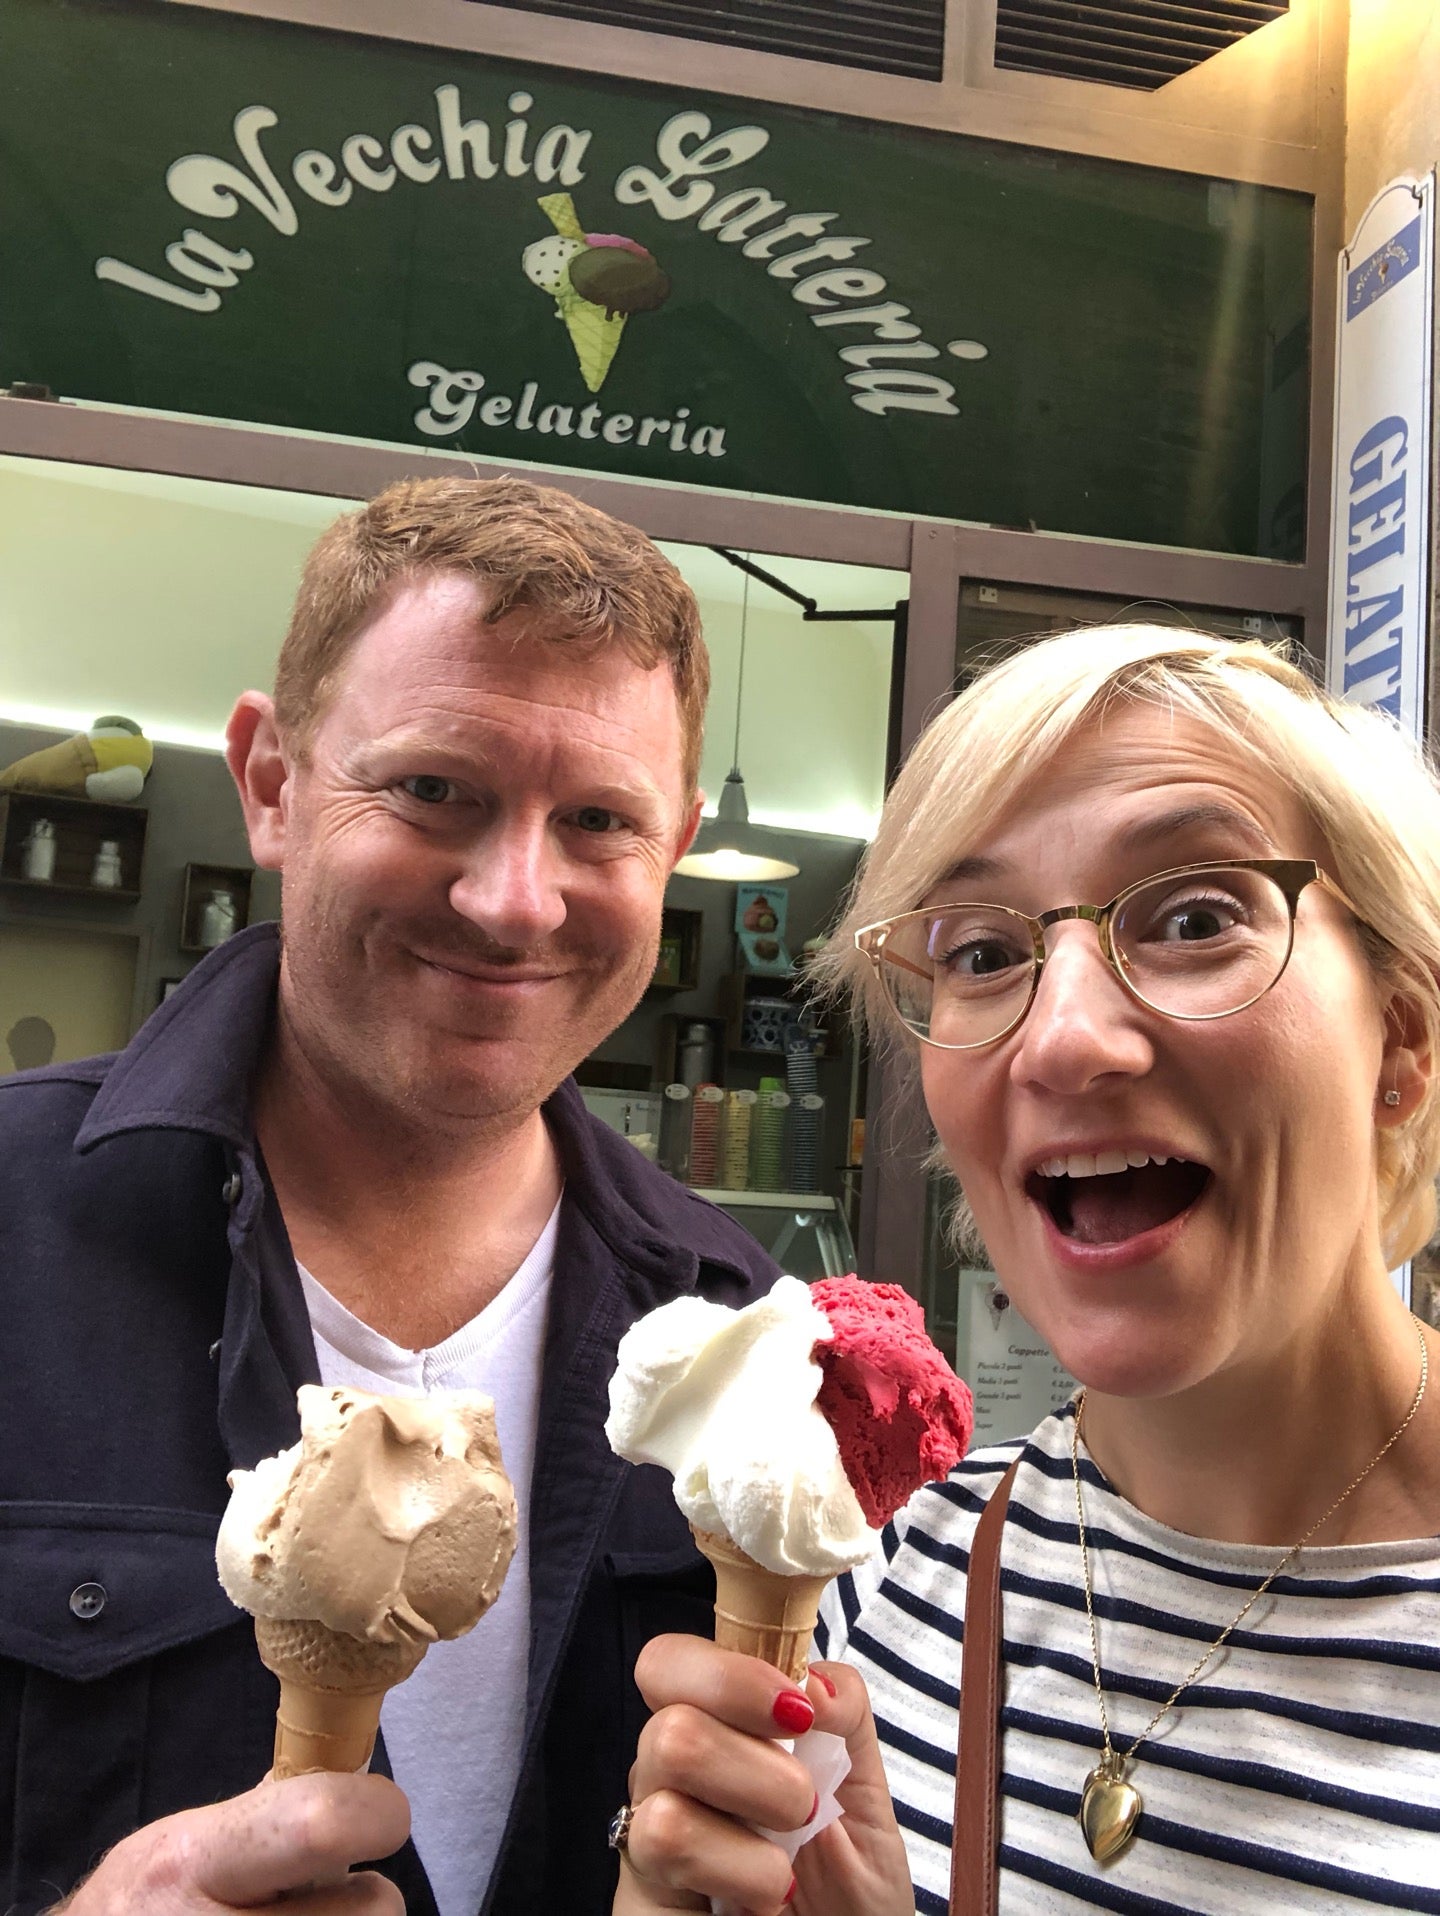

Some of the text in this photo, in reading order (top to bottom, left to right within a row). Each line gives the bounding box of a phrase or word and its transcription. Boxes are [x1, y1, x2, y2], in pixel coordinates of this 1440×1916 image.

[96, 84, 988, 418] la Vecchia Latteria
[407, 361, 727, 459] Gelateria
